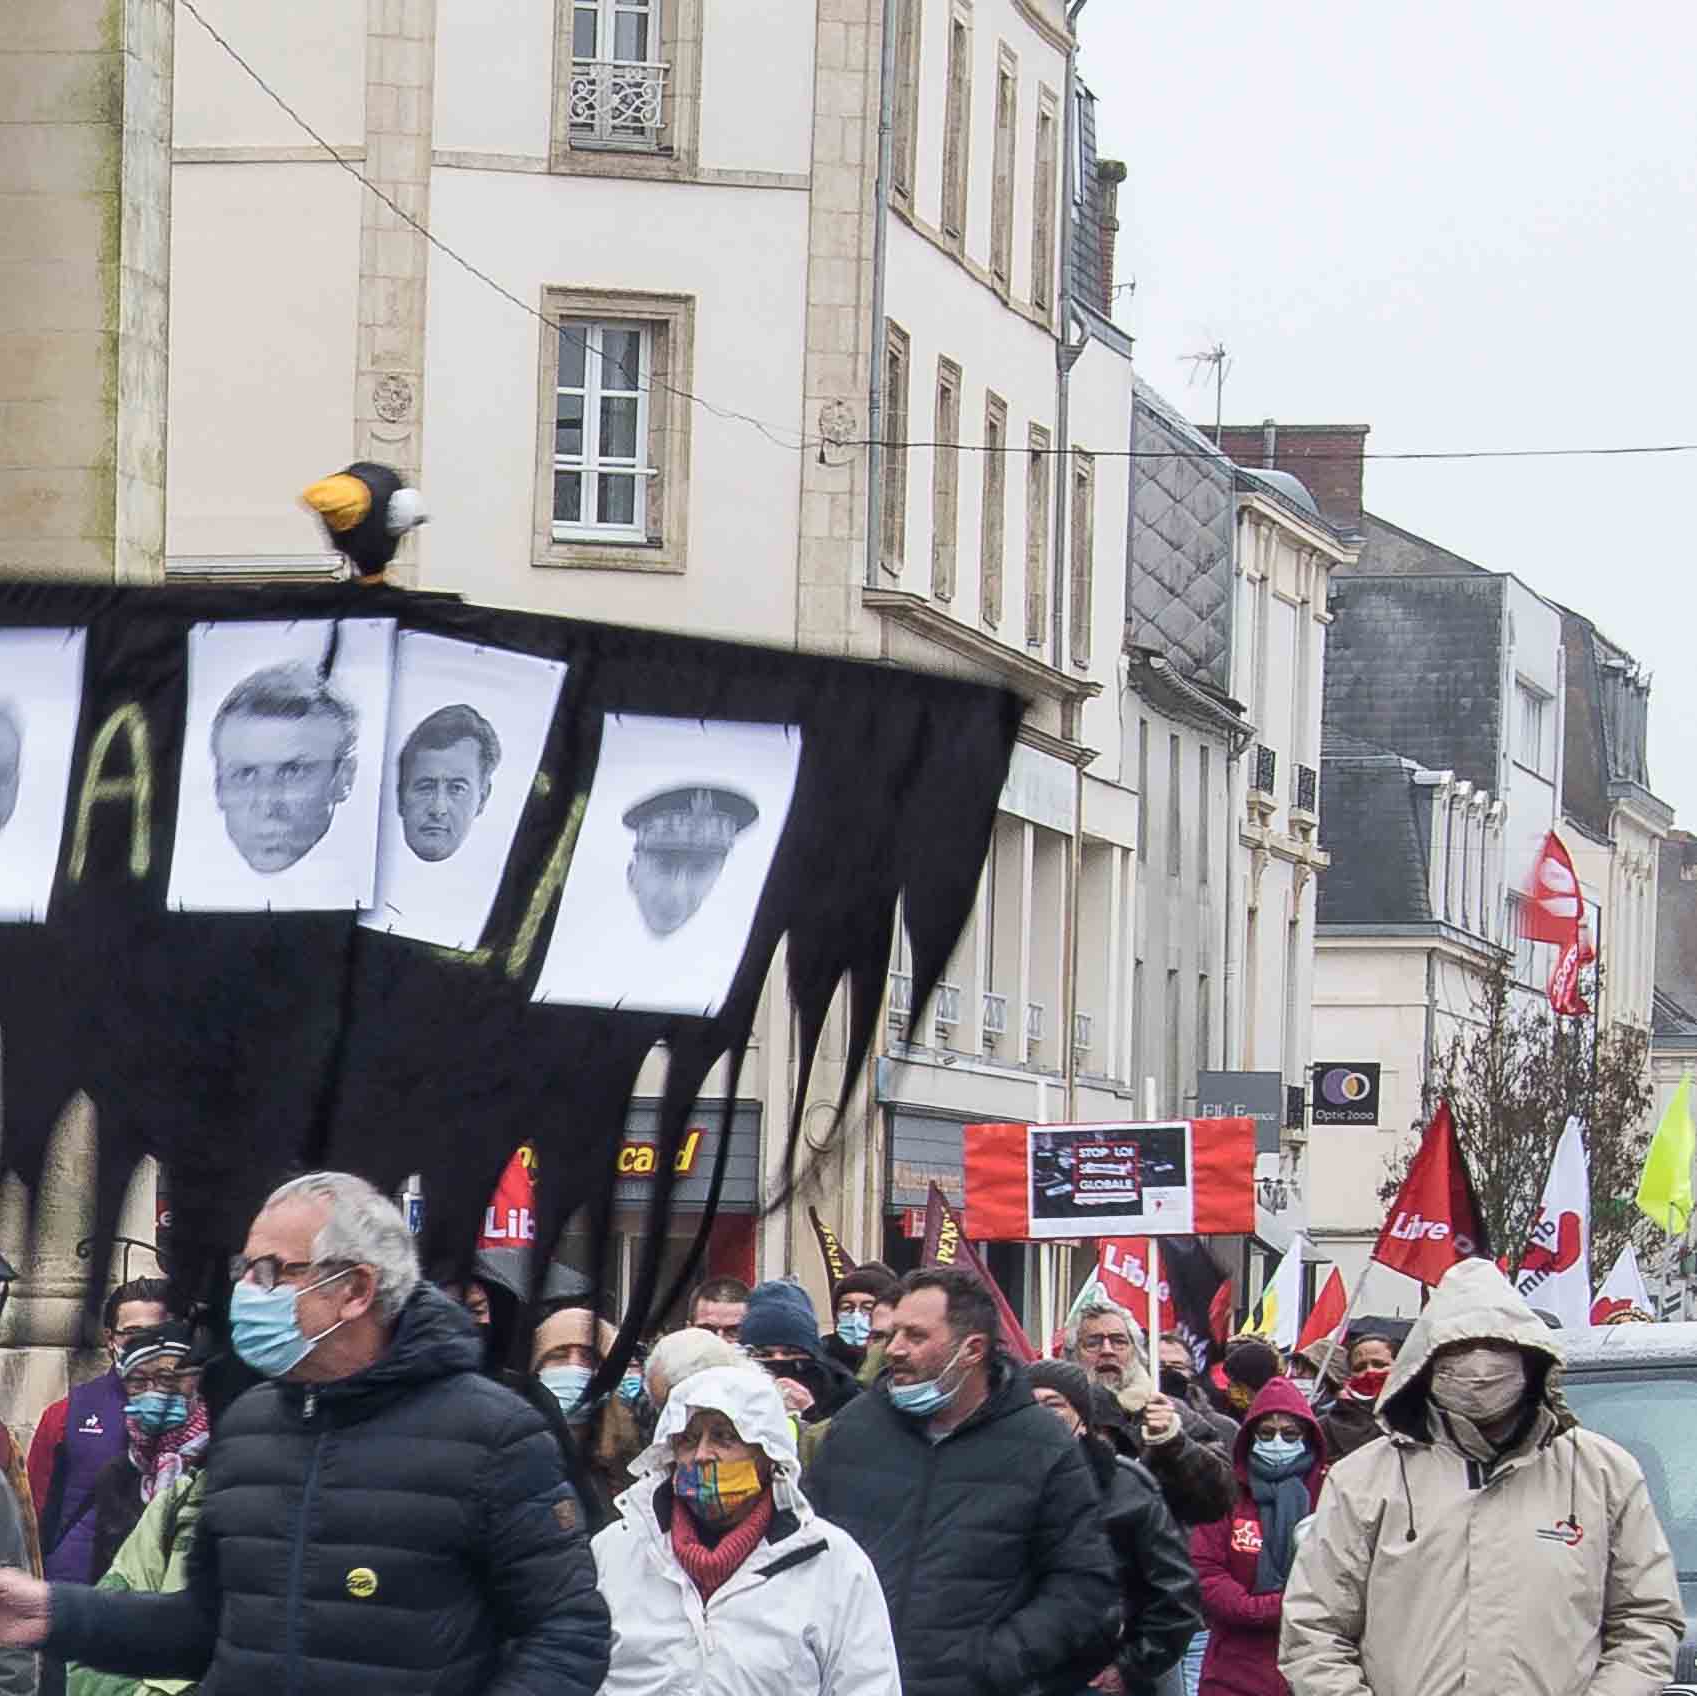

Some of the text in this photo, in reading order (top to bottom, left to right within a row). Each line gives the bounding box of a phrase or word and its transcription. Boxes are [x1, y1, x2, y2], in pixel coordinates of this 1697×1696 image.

[1315, 1108, 1375, 1121] Optic 2000
[1078, 1146, 1135, 1158] STOP LOI
[1079, 1179, 1135, 1190] GLOBALE
